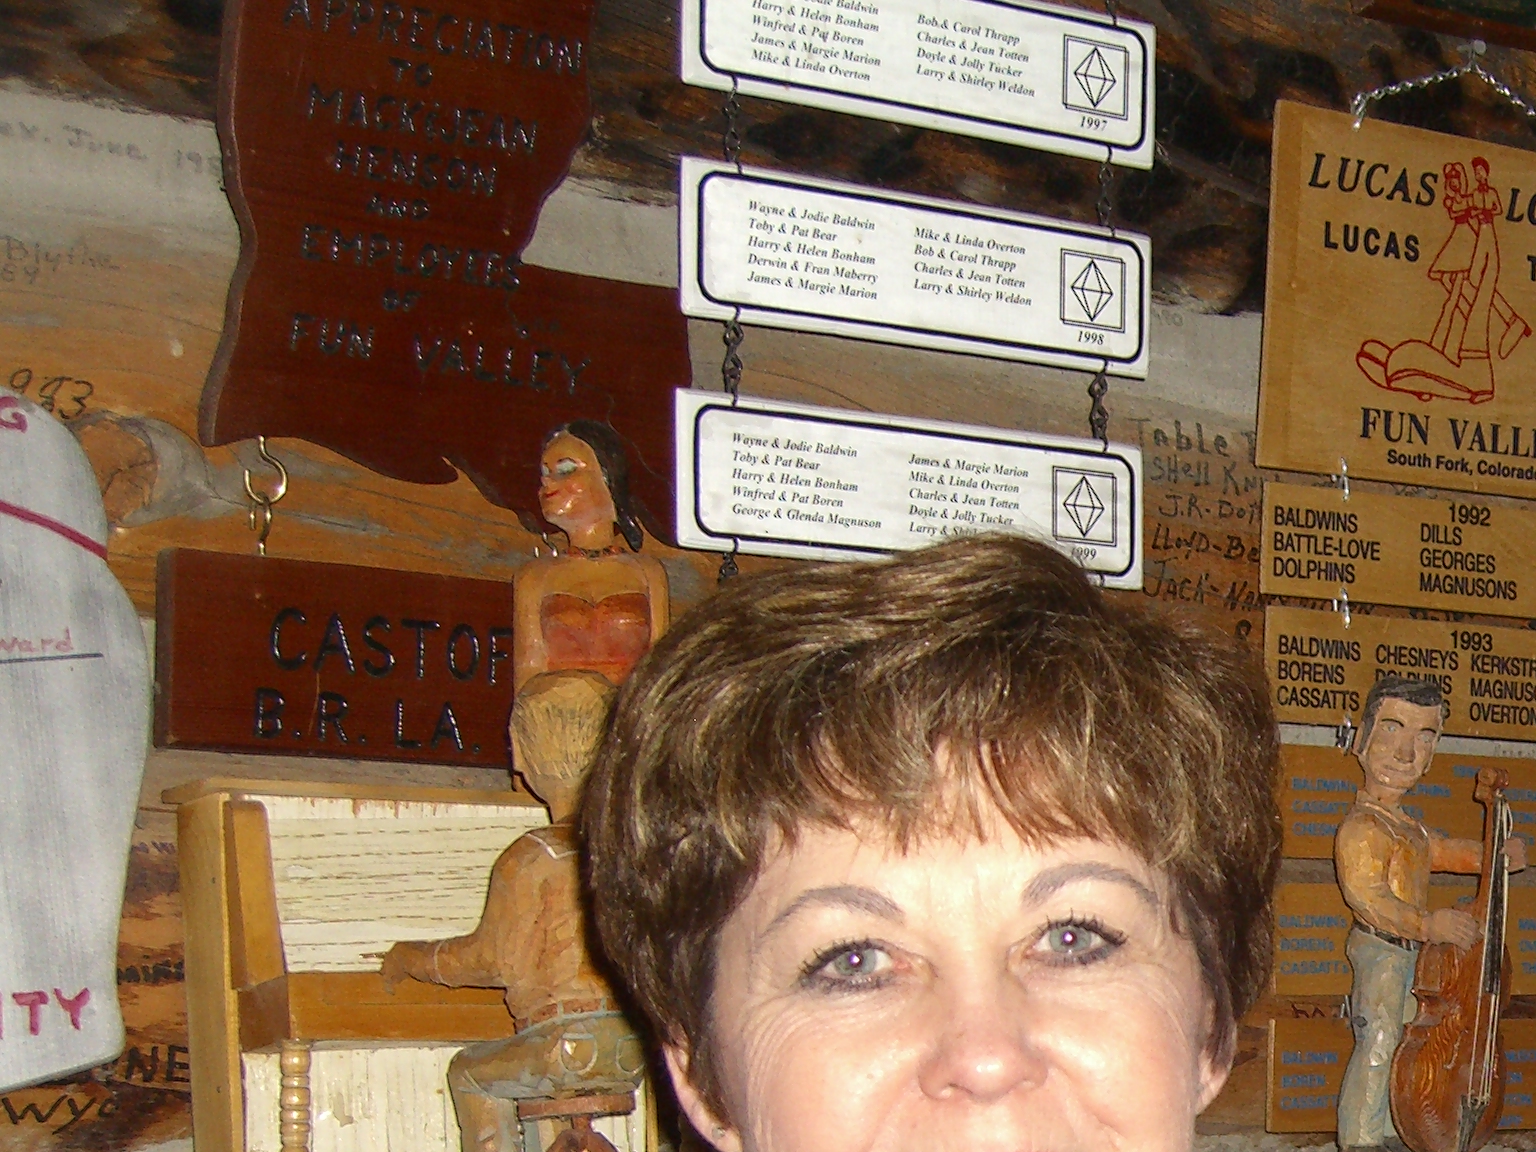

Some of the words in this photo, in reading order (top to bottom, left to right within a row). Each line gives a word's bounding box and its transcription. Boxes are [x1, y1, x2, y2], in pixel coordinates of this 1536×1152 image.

[917, 14, 938, 27] Bob
[941, 19, 949, 30] &
[954, 21, 980, 36] Carol
[984, 28, 1019, 47] Thrapp
[917, 31, 955, 48] Charles
[959, 40, 966, 50] &
[971, 42, 994, 55] Jean
[999, 48, 1029, 62] Totten
[389, 57, 433, 86] TO
[917, 47, 946, 63] Doyle
[949, 56, 957, 65] &
[961, 58, 985, 72] Jolly
[988, 63, 1022, 78] Tucker
[917, 64, 945, 81] Larry
[948, 72, 956, 81] &
[960, 73, 995, 91] Shirley
[999, 80, 1035, 97] Weldon
[1080, 116, 1107, 131] 1997
[334, 139, 497, 195] HENSON
[1308, 152, 1438, 207] LUCAS
[366, 193, 430, 220] AND
[749, 201, 785, 216] Wayne
[788, 208, 796, 218] &
[801, 209, 829, 223] Jodie
[833, 213, 875, 230] Baldwin
[749, 218, 774, 234] Toby
[778, 224, 786, 234] &
[792, 224, 809, 237] Pat
[812, 228, 837, 241] Bear
[1324, 221, 1420, 262] LUCAS
[303, 226, 521, 291] EMPLOYEES
[748, 235, 780, 252] Harry
[784, 242, 792, 252] &
[796, 244, 828, 258] Helen
[831, 249, 875, 265] Bonham
[748, 253, 787, 269] Derwin
[791, 261, 799, 271] &
[805, 262, 830, 275] Fran
[833, 266, 878, 284] Maberry
[383, 288, 421, 311] OF
[290, 312, 374, 359] FUN
[414, 333, 590, 394] VALLEY
[1078, 331, 1104, 345] 1998
[1360, 407, 1430, 445] FUN
[733, 432, 768, 448] Wayne
[771, 438, 779, 448] &
[784, 439, 812, 453] Jodie
[816, 443, 857, 458] Baldwin
[1387, 449, 1431, 470] South
[1436, 455, 1472, 476] Fork,
[733, 486, 775, 500] Winfred
[778, 491, 786, 501] &
[792, 492, 809, 503] Pat
[813, 495, 843, 507] Boren
[733, 503, 770, 519] George
[774, 508, 782, 518] &
[788, 509, 824, 523] Glenda
[828, 513, 881, 529] Magnuson
[1274, 505, 1358, 533] BALDWINS
[1420, 523, 1462, 545] DILLS
[1449, 503, 1491, 527] 1992
[1273, 532, 1380, 561] BATTLE-LOVE
[1420, 549, 1495, 573] GEORGES
[1273, 557, 1355, 584] DOLPHINS
[1419, 572, 1517, 600] MAGNUSONS
[1278, 635, 1360, 662] BALDWINS
[1375, 644, 1458, 671] CHESNEYS
[1450, 630, 1493, 653] 1993
[1278, 660, 1345, 685] BORENS
[1277, 685, 1359, 711] CASSATTS
